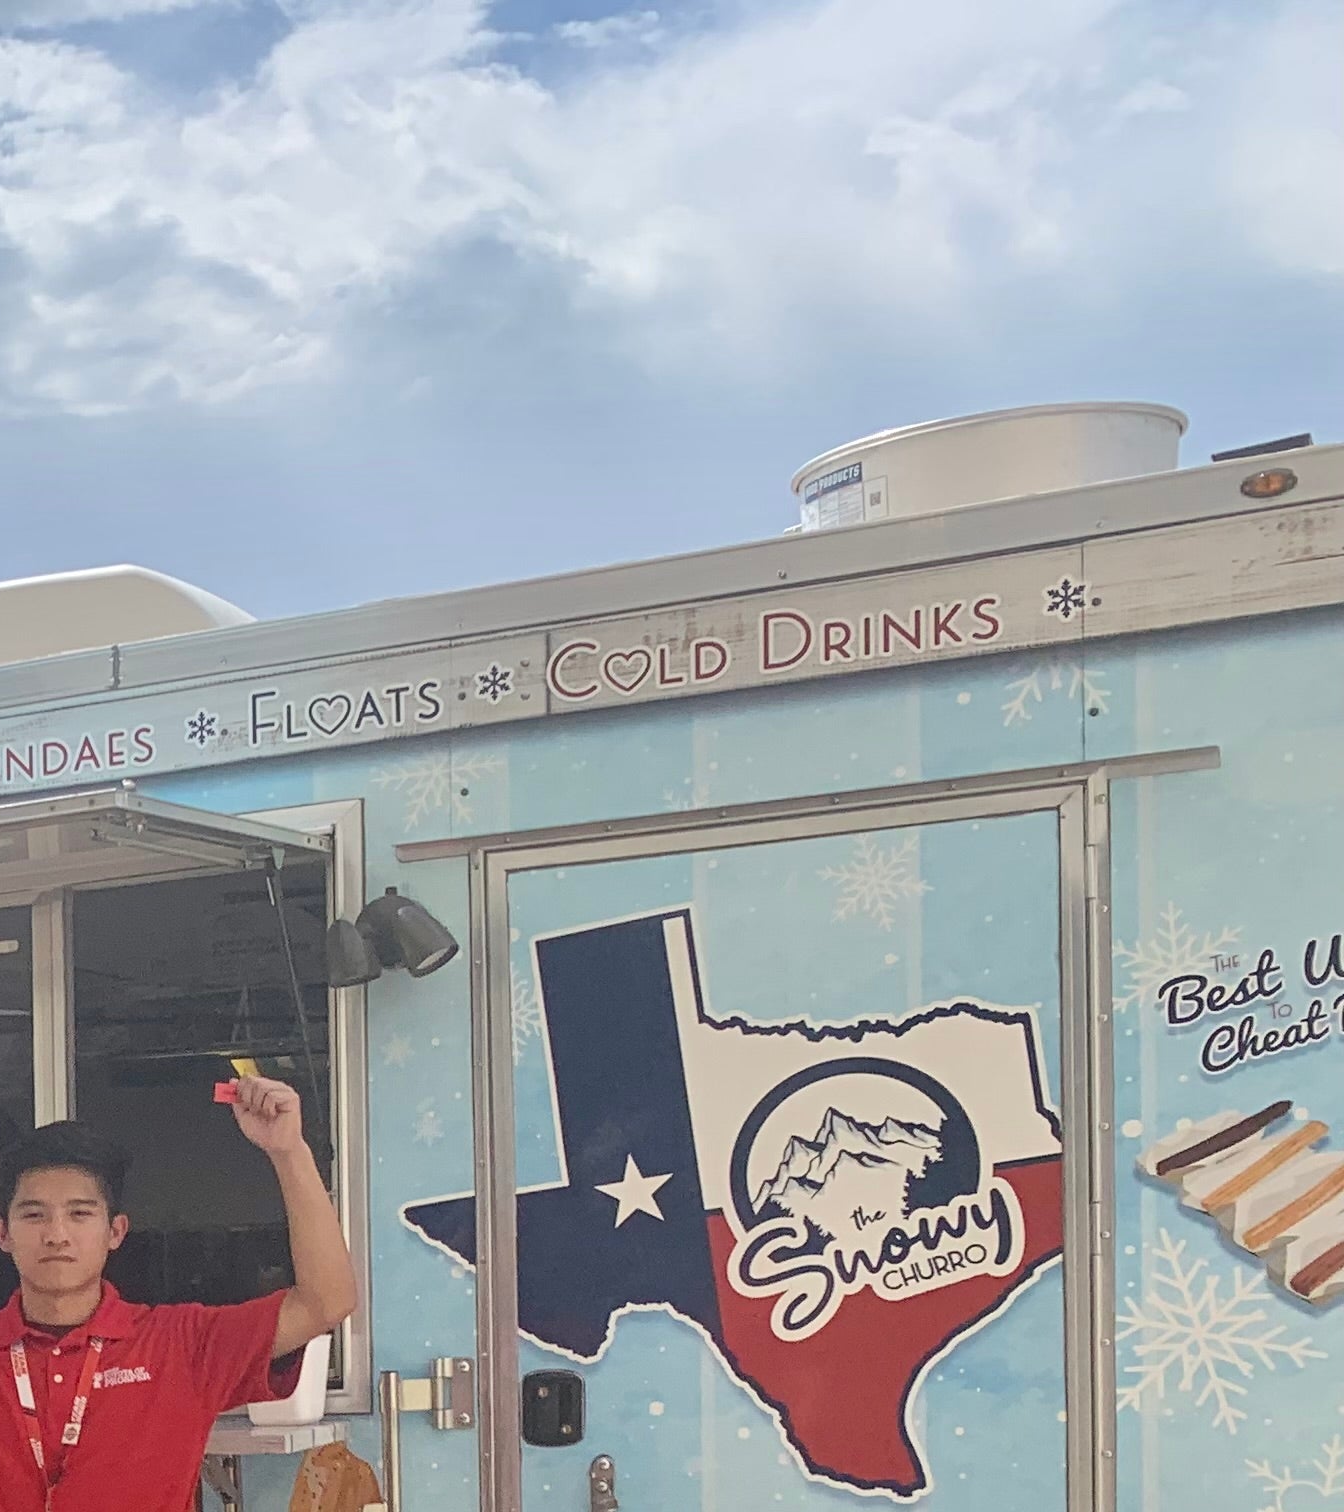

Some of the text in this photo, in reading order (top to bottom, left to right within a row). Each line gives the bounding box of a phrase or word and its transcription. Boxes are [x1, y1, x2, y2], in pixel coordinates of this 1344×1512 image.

[248, 685, 441, 746] FLOATS
[549, 640, 727, 699] COLD
[762, 597, 1000, 672] DRINKS
[1158, 949, 1283, 1025] Best
[1209, 954, 1240, 973] THE
[1202, 1000, 1329, 1073] Cheat
[1267, 1003, 1293, 1020] TO
[850, 1206, 885, 1232] the
[739, 1187, 1012, 1332] Snowy
[881, 1244, 987, 1291] CHURRO
